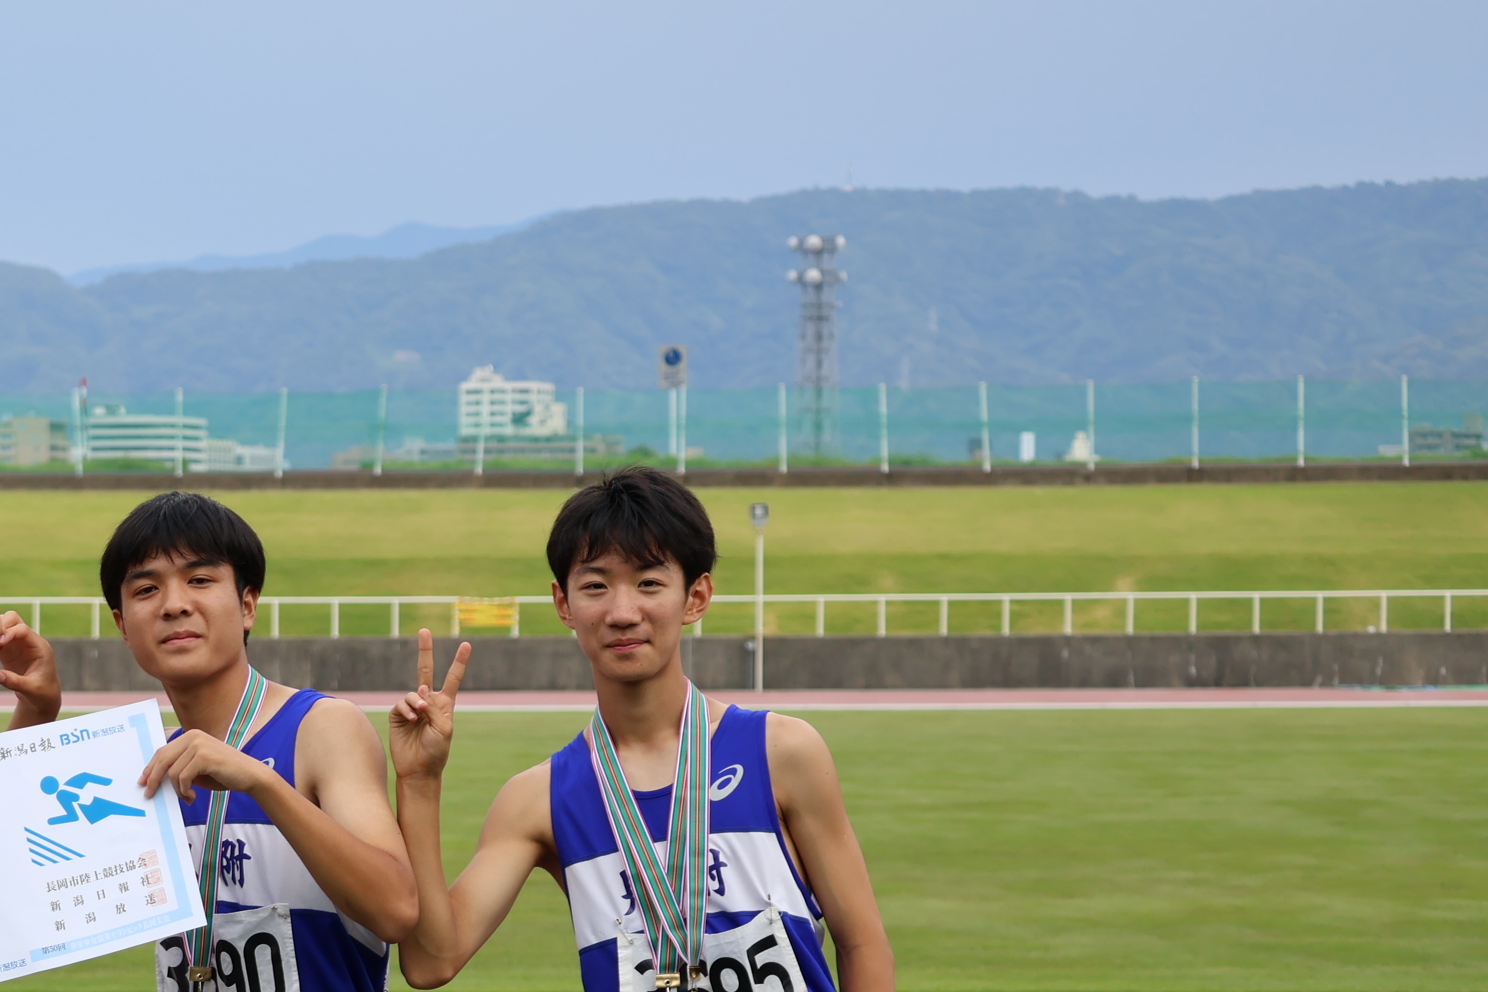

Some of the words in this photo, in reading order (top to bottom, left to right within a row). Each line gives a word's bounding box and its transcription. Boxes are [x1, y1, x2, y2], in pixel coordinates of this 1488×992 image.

[91, 724, 126, 739] 新潟放送
[46, 856, 148, 893] 長岡市陸上競技協会
[50, 874, 152, 912] 新潟日報社
[54, 893, 157, 932] 新潟放送
[41, 943, 67, 955] 第50回
